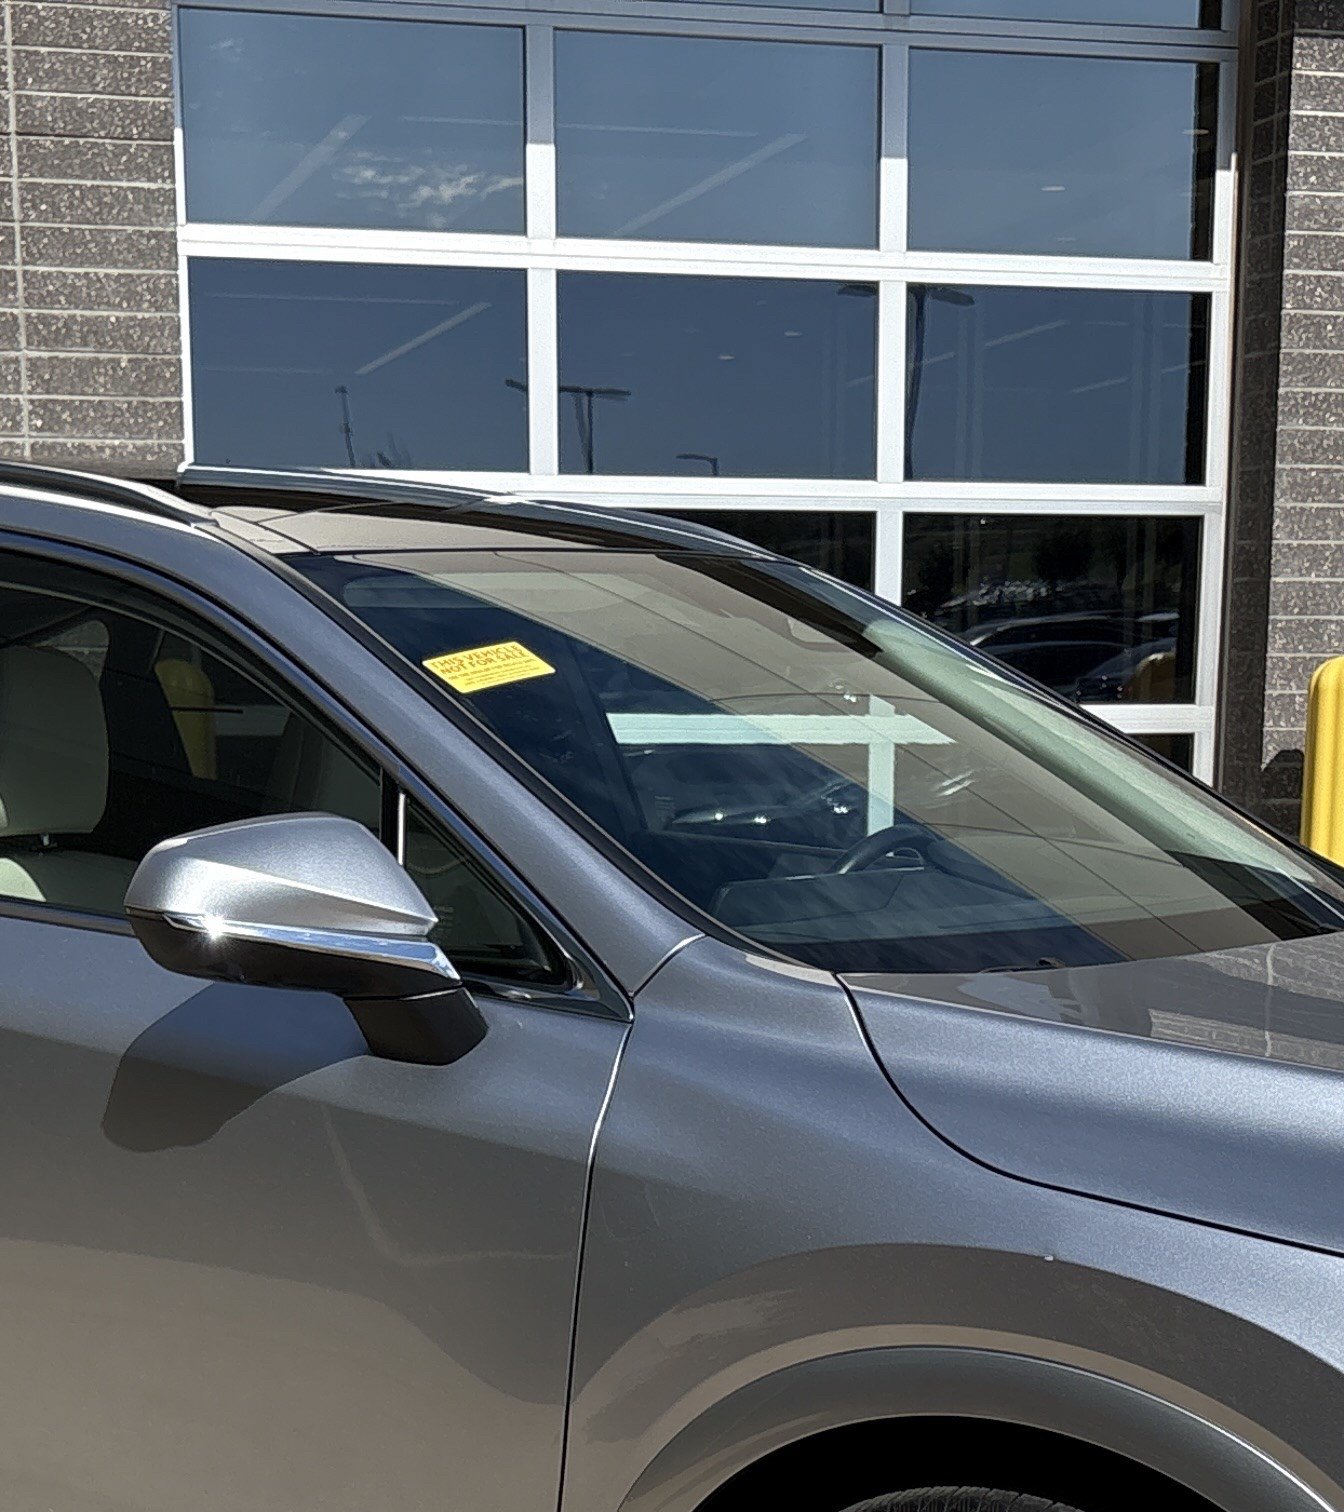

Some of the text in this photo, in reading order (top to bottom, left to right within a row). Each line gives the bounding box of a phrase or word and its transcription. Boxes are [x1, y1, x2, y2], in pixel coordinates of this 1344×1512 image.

[431, 645, 519, 669] THIS VEHICLE
[440, 662, 467, 674] NOT
[468, 657, 495, 667] FOR
[496, 648, 529, 661] SALE
